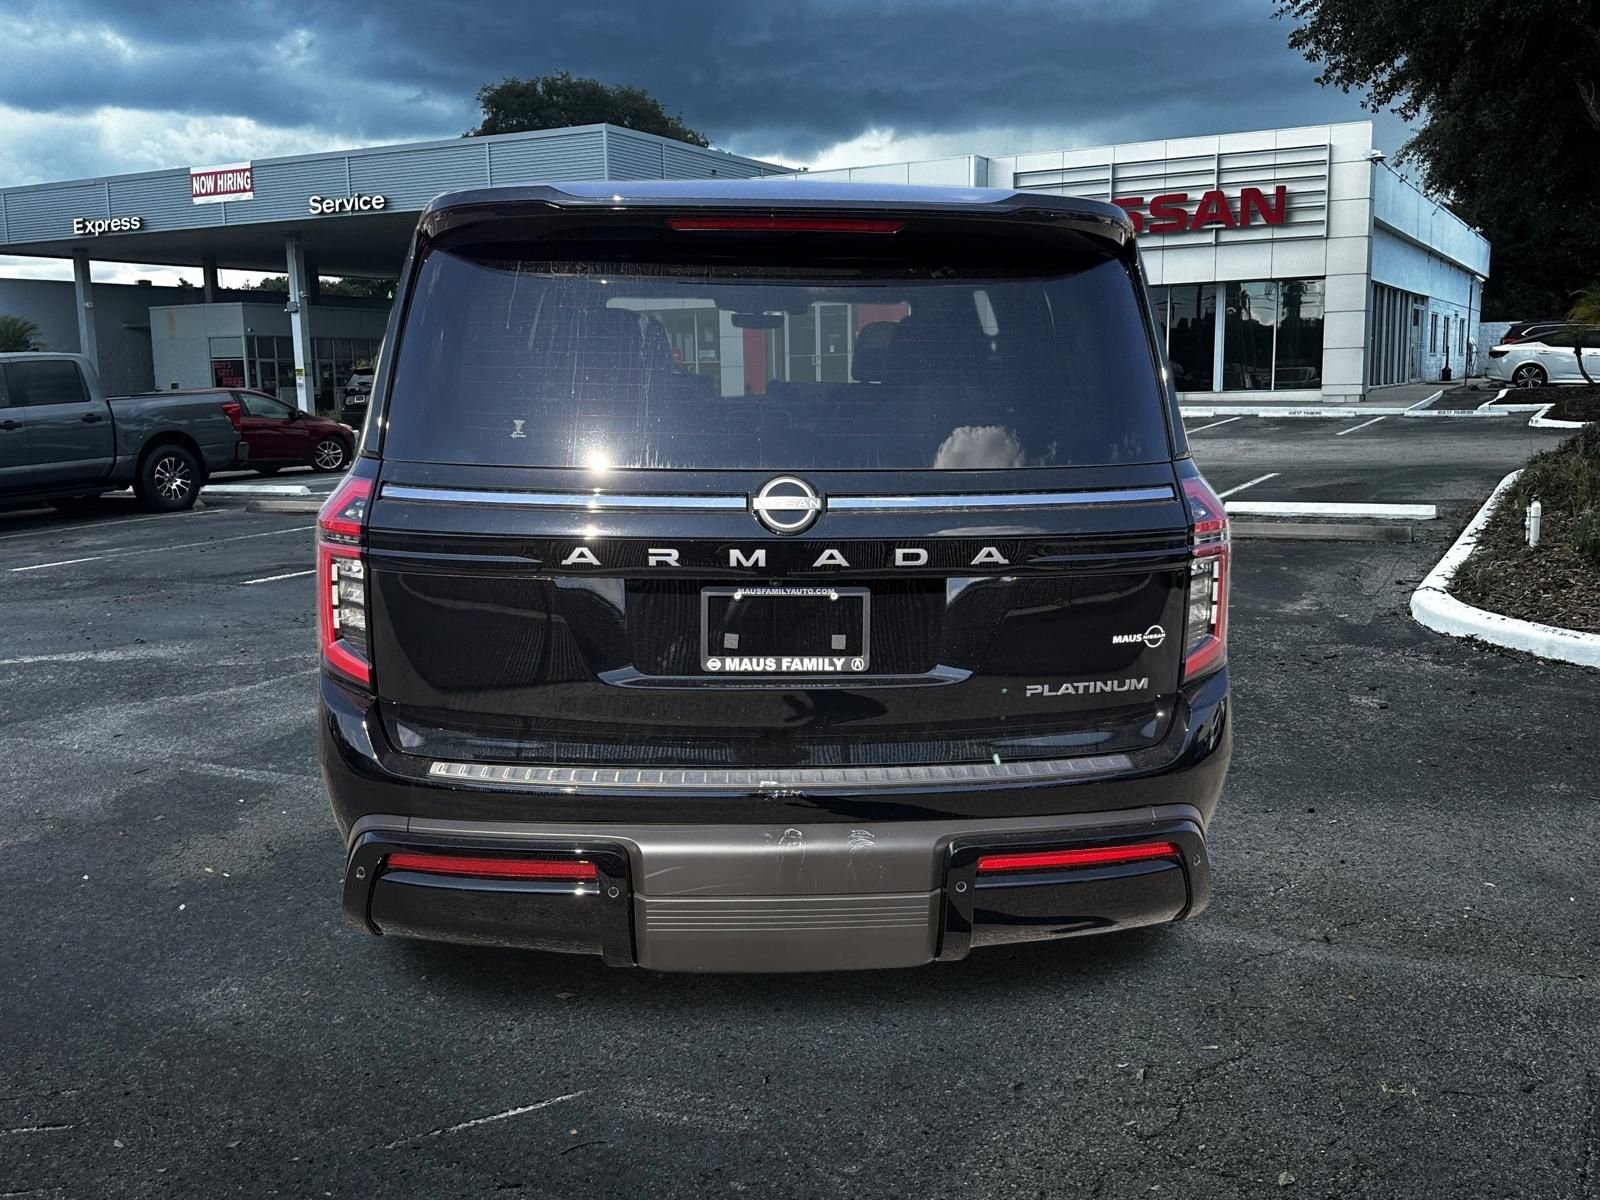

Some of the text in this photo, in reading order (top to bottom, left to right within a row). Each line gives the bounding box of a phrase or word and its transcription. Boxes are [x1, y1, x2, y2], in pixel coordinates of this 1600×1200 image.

[192, 171, 251, 195] NOW HIRING
[309, 193, 385, 214] Service
[73, 216, 141, 237] Express
[561, 546, 1009, 567] ARMADA
[1112, 633, 1142, 644] MAUS
[725, 658, 845, 671] MAUS FAMILY
[1025, 677, 1149, 697] PLATINUM
